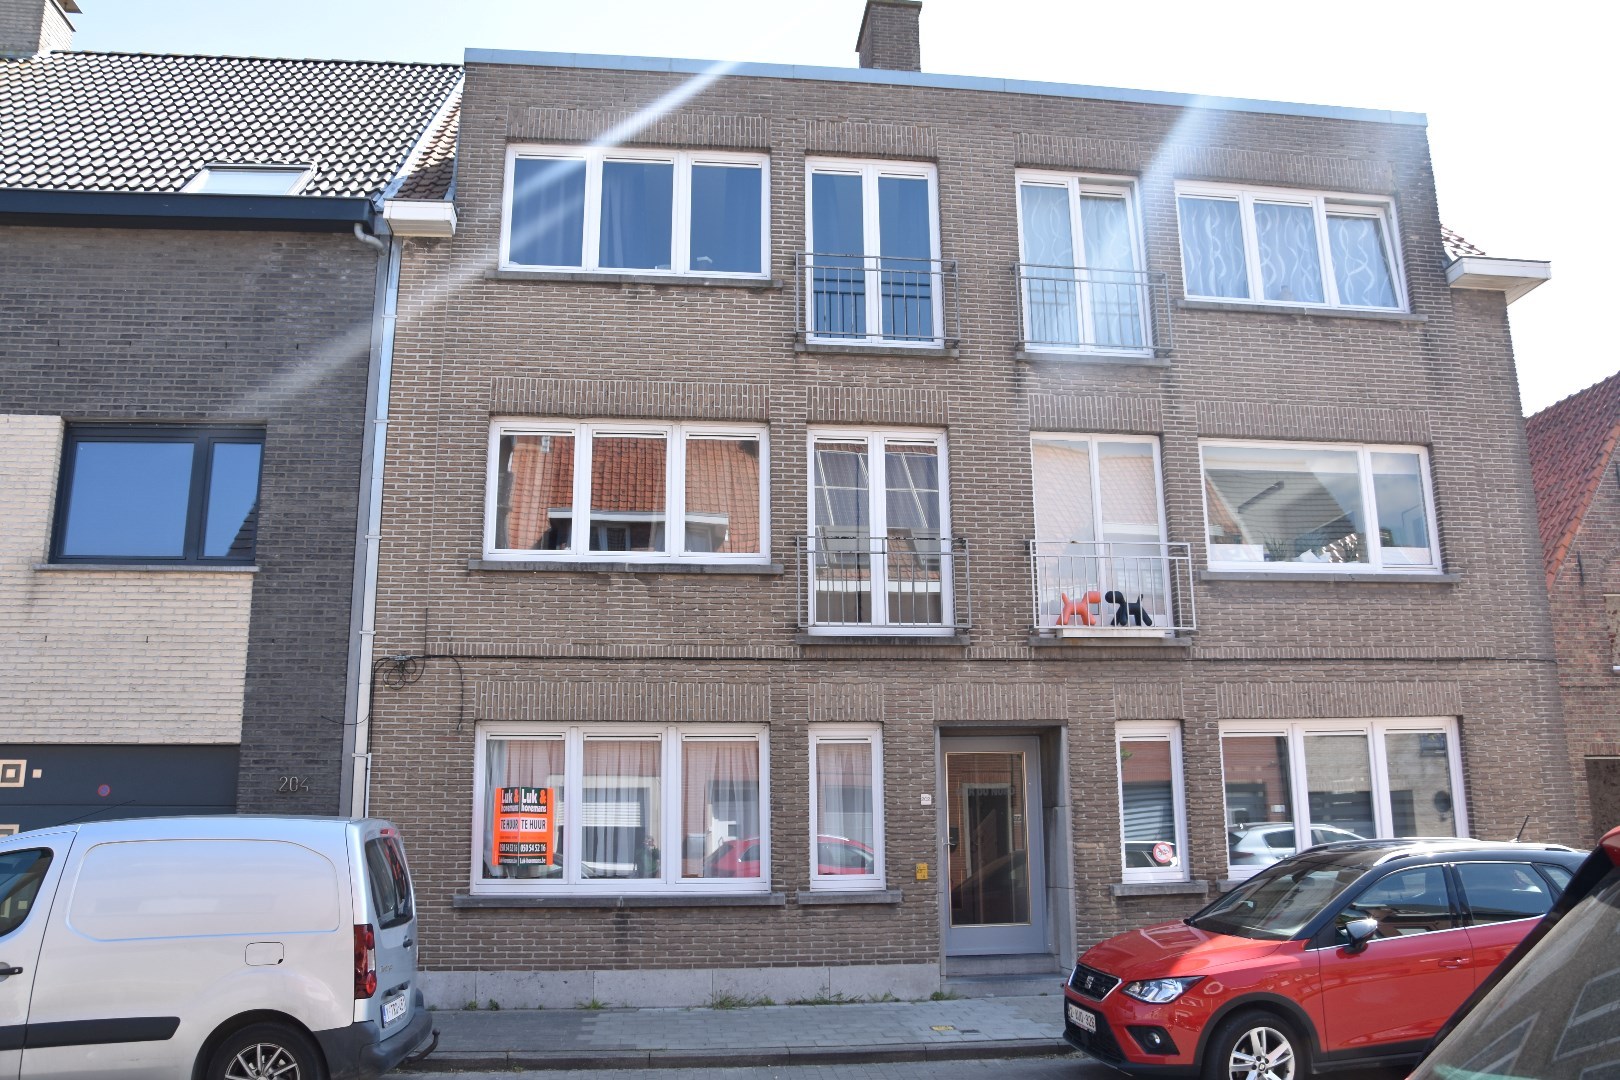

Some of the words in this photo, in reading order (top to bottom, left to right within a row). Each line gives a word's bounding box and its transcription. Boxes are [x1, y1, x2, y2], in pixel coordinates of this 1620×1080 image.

[279, 776, 309, 791] 204
[502, 790, 513, 803] Luk
[521, 788, 537, 804] Luk
[539, 789, 547, 805] &
[520, 803, 547, 813] horemans
[500, 820, 506, 830] TE
[521, 819, 528, 829] TE
[529, 819, 546, 829] HUUR
[520, 843, 529, 852] 050
[528, 843, 534, 852] 54
[534, 843, 541, 852] 52
